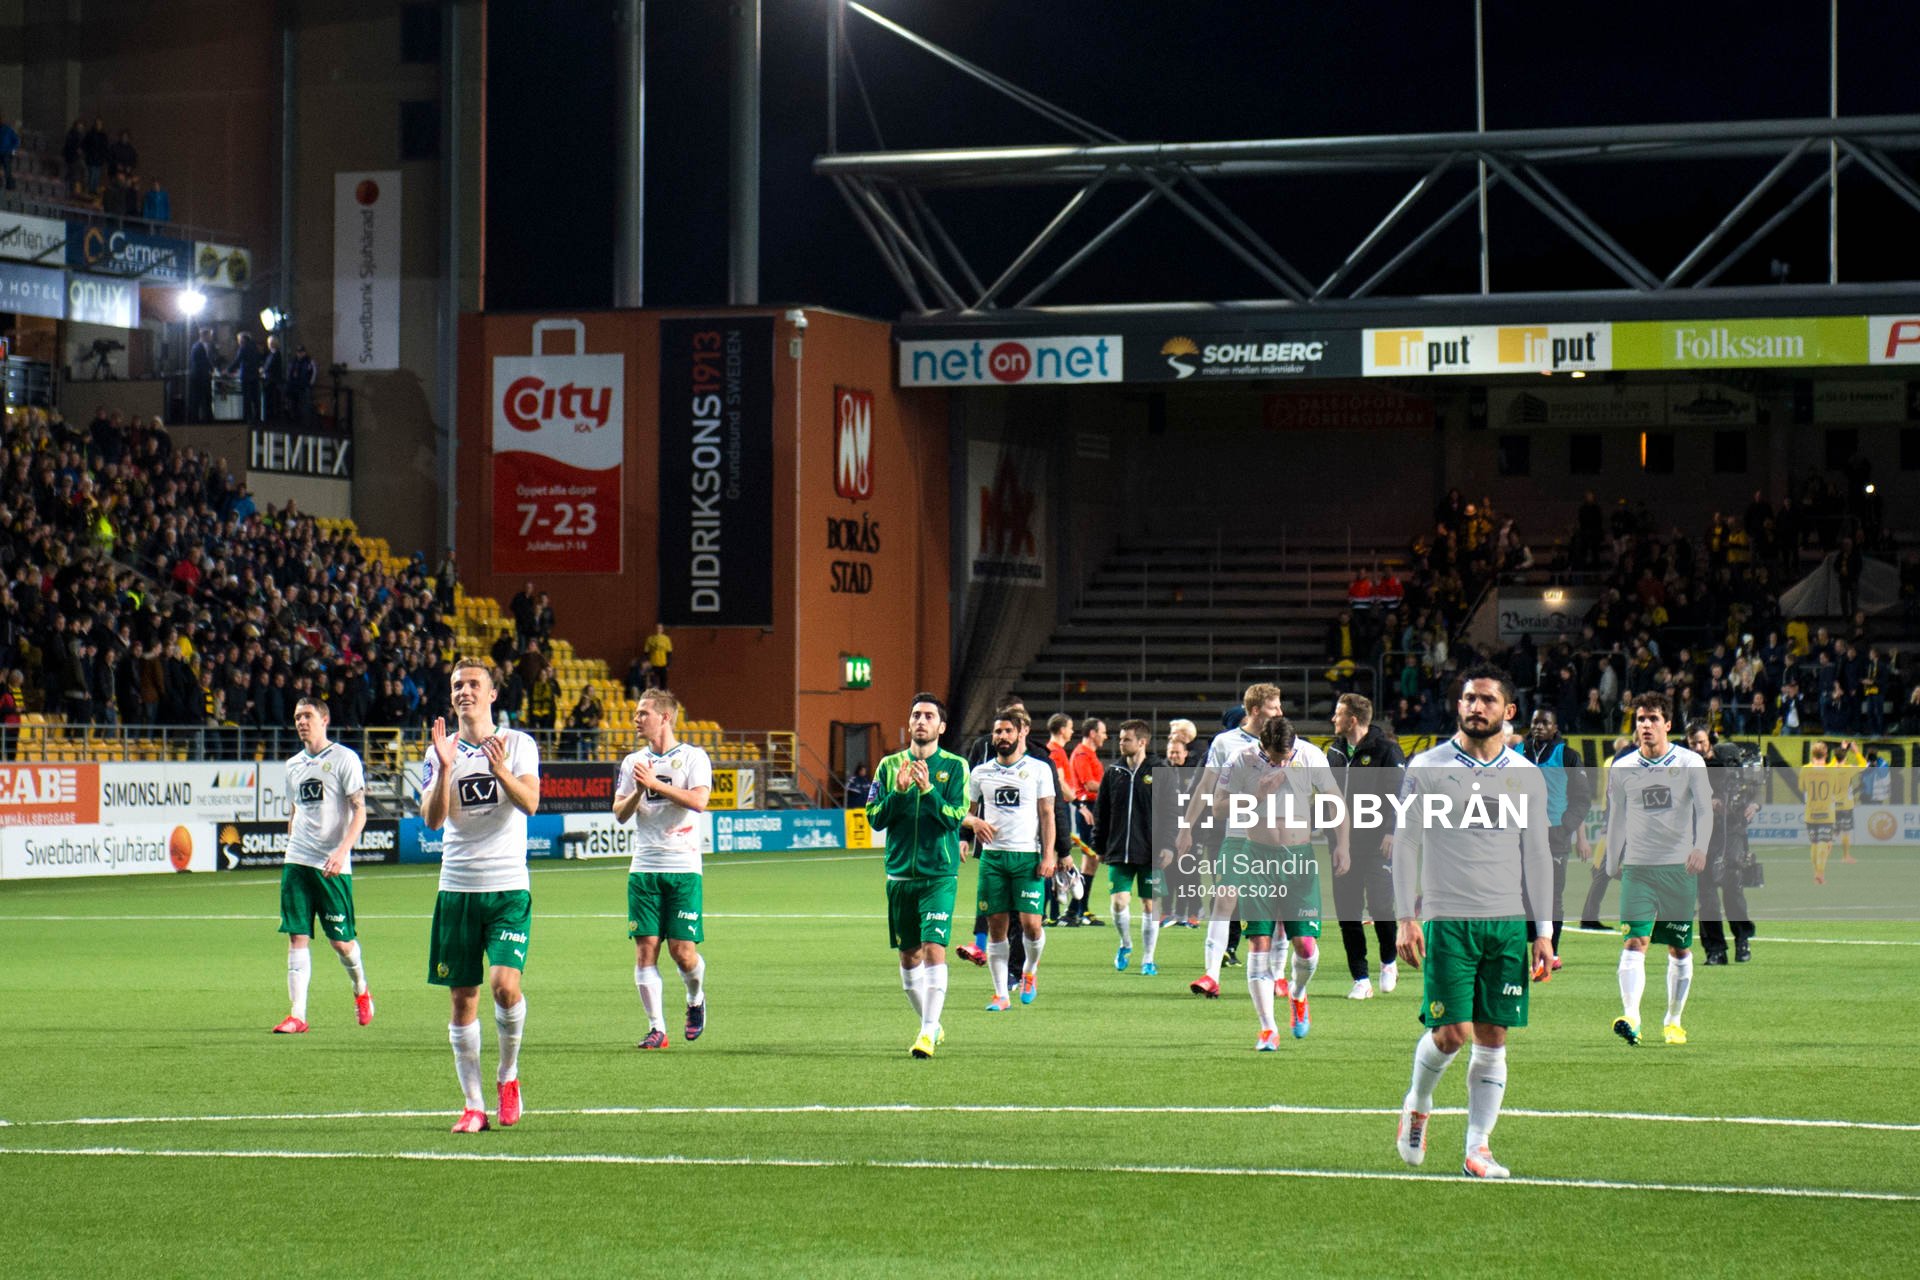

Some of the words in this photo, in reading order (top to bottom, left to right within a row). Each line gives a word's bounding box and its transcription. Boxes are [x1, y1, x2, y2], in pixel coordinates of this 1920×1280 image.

[359, 209, 377, 279] Sjuhärad
[10, 281, 58, 300] HOTEL
[359, 284, 374, 363] Swedbank
[913, 342, 983, 382] net
[994, 353, 1026, 372] on
[1036, 338, 1110, 378] net
[1202, 341, 1323, 364] SOHLBERG
[1674, 328, 1804, 360] Folksam
[726, 329, 743, 406] SWEDEN
[1232, 365, 1260, 375] mellan
[503, 376, 612, 432] City
[251, 430, 349, 475] HEMTEX
[726, 410, 742, 500] Grundsund
[517, 503, 597, 536] 7-23
[827, 512, 881, 554] BORÅS
[830, 560, 873, 594] STAD
[104, 782, 191, 807] SIMONSLAND
[1810, 780, 1830, 802] 10
[25, 838, 100, 866] Swedbank
[104, 835, 166, 868] Sjuhärad
